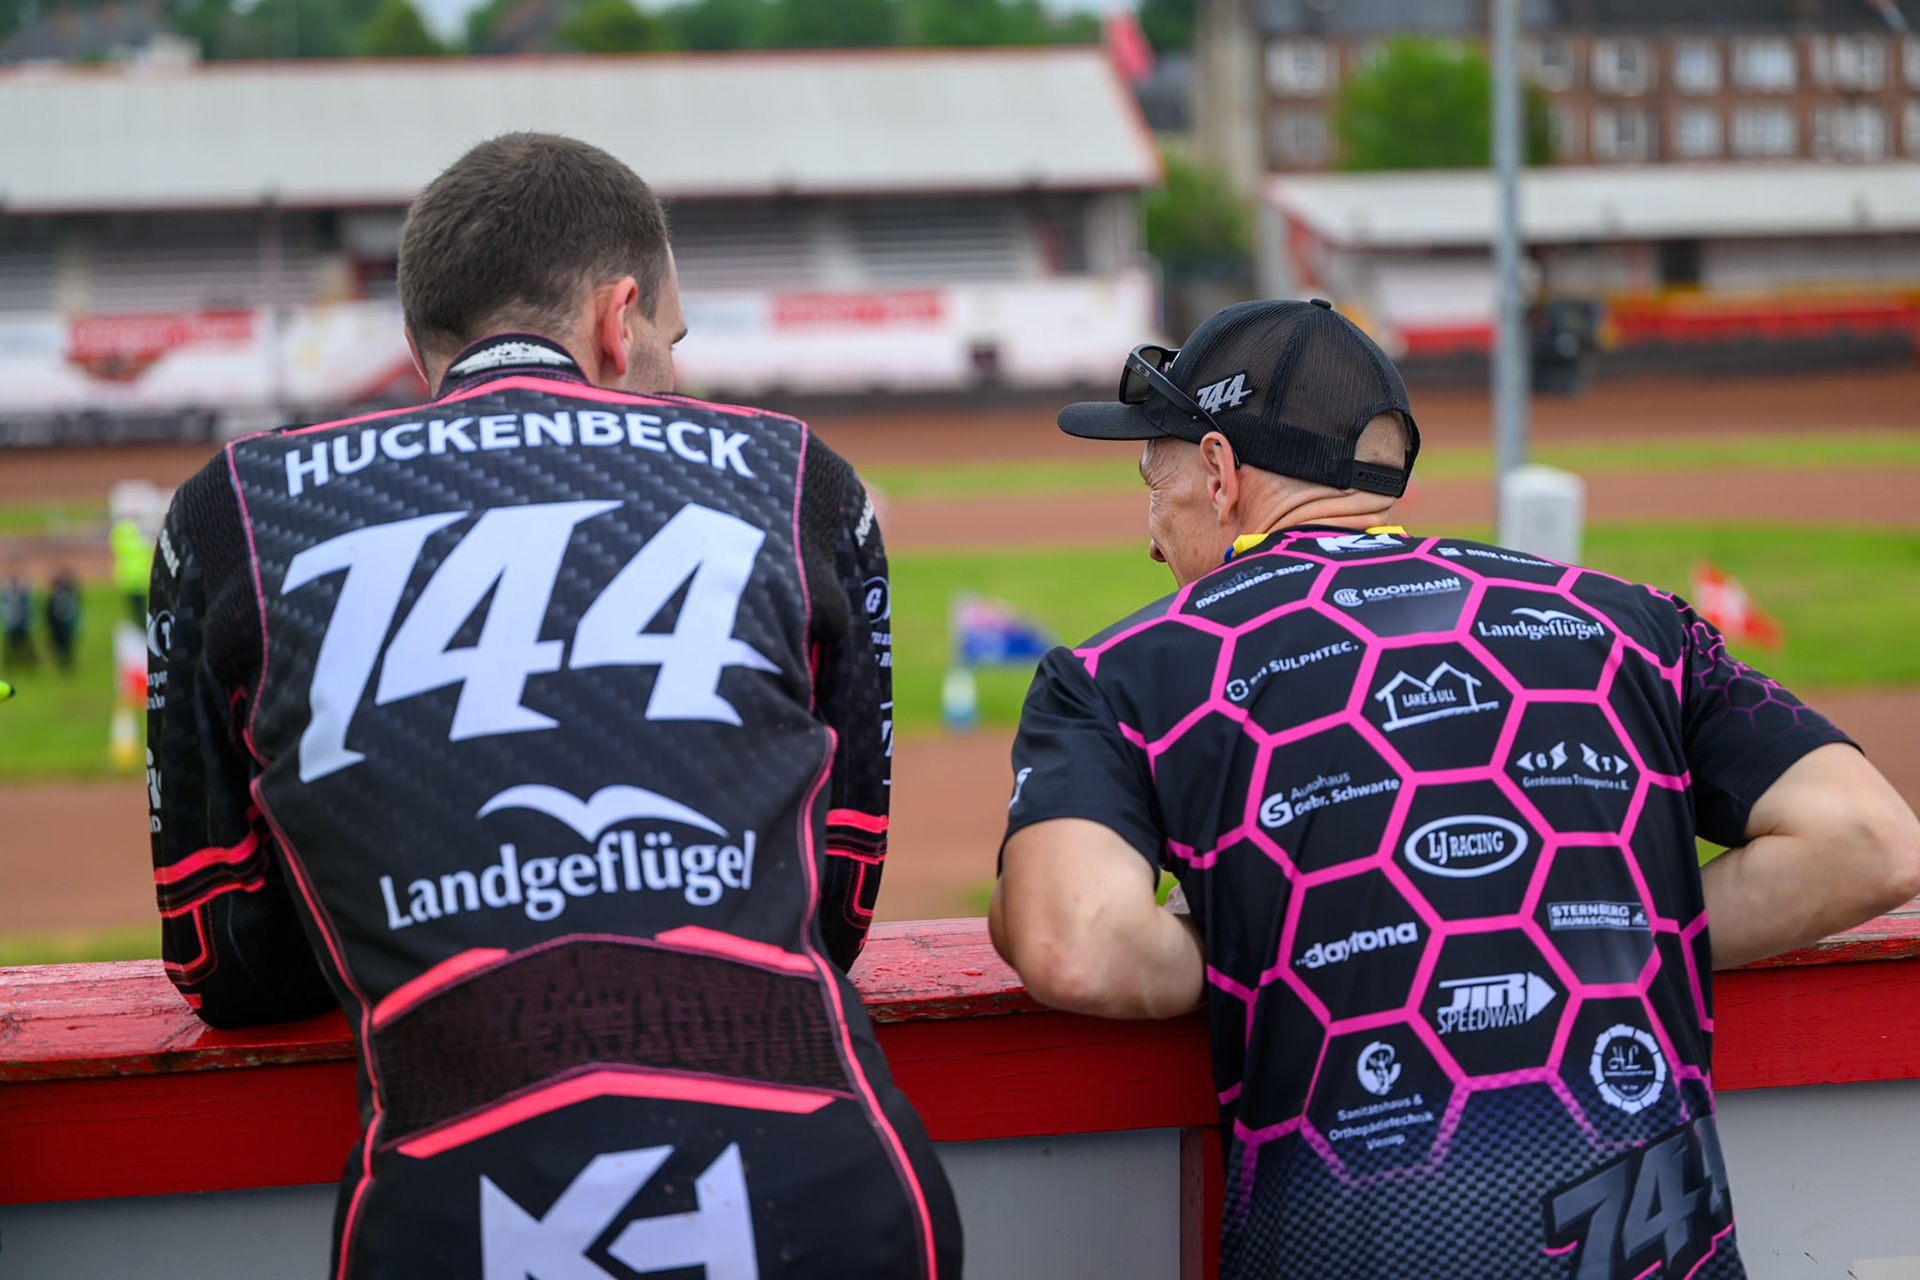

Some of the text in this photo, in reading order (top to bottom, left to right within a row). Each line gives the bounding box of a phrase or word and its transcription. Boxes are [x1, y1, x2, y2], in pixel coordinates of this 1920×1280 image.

[1195, 373, 1253, 414] 744
[285, 410, 755, 497] HUCKENBECK
[1362, 577, 1461, 599] KOOPMANN
[280, 500, 783, 783] 744
[1477, 620, 1606, 641] Landgeflügel
[1290, 771, 1351, 801] Autohaus
[1294, 795, 1331, 816] Gebr.
[1330, 778, 1400, 804] Schwarte
[1449, 830, 1505, 857] RACING
[379, 829, 757, 931] Landgeflügel
[1551, 903, 1630, 918] STERNBERG
[1300, 921, 1419, 969] daytona
[1437, 1003, 1526, 1036] SPEEDWAY
